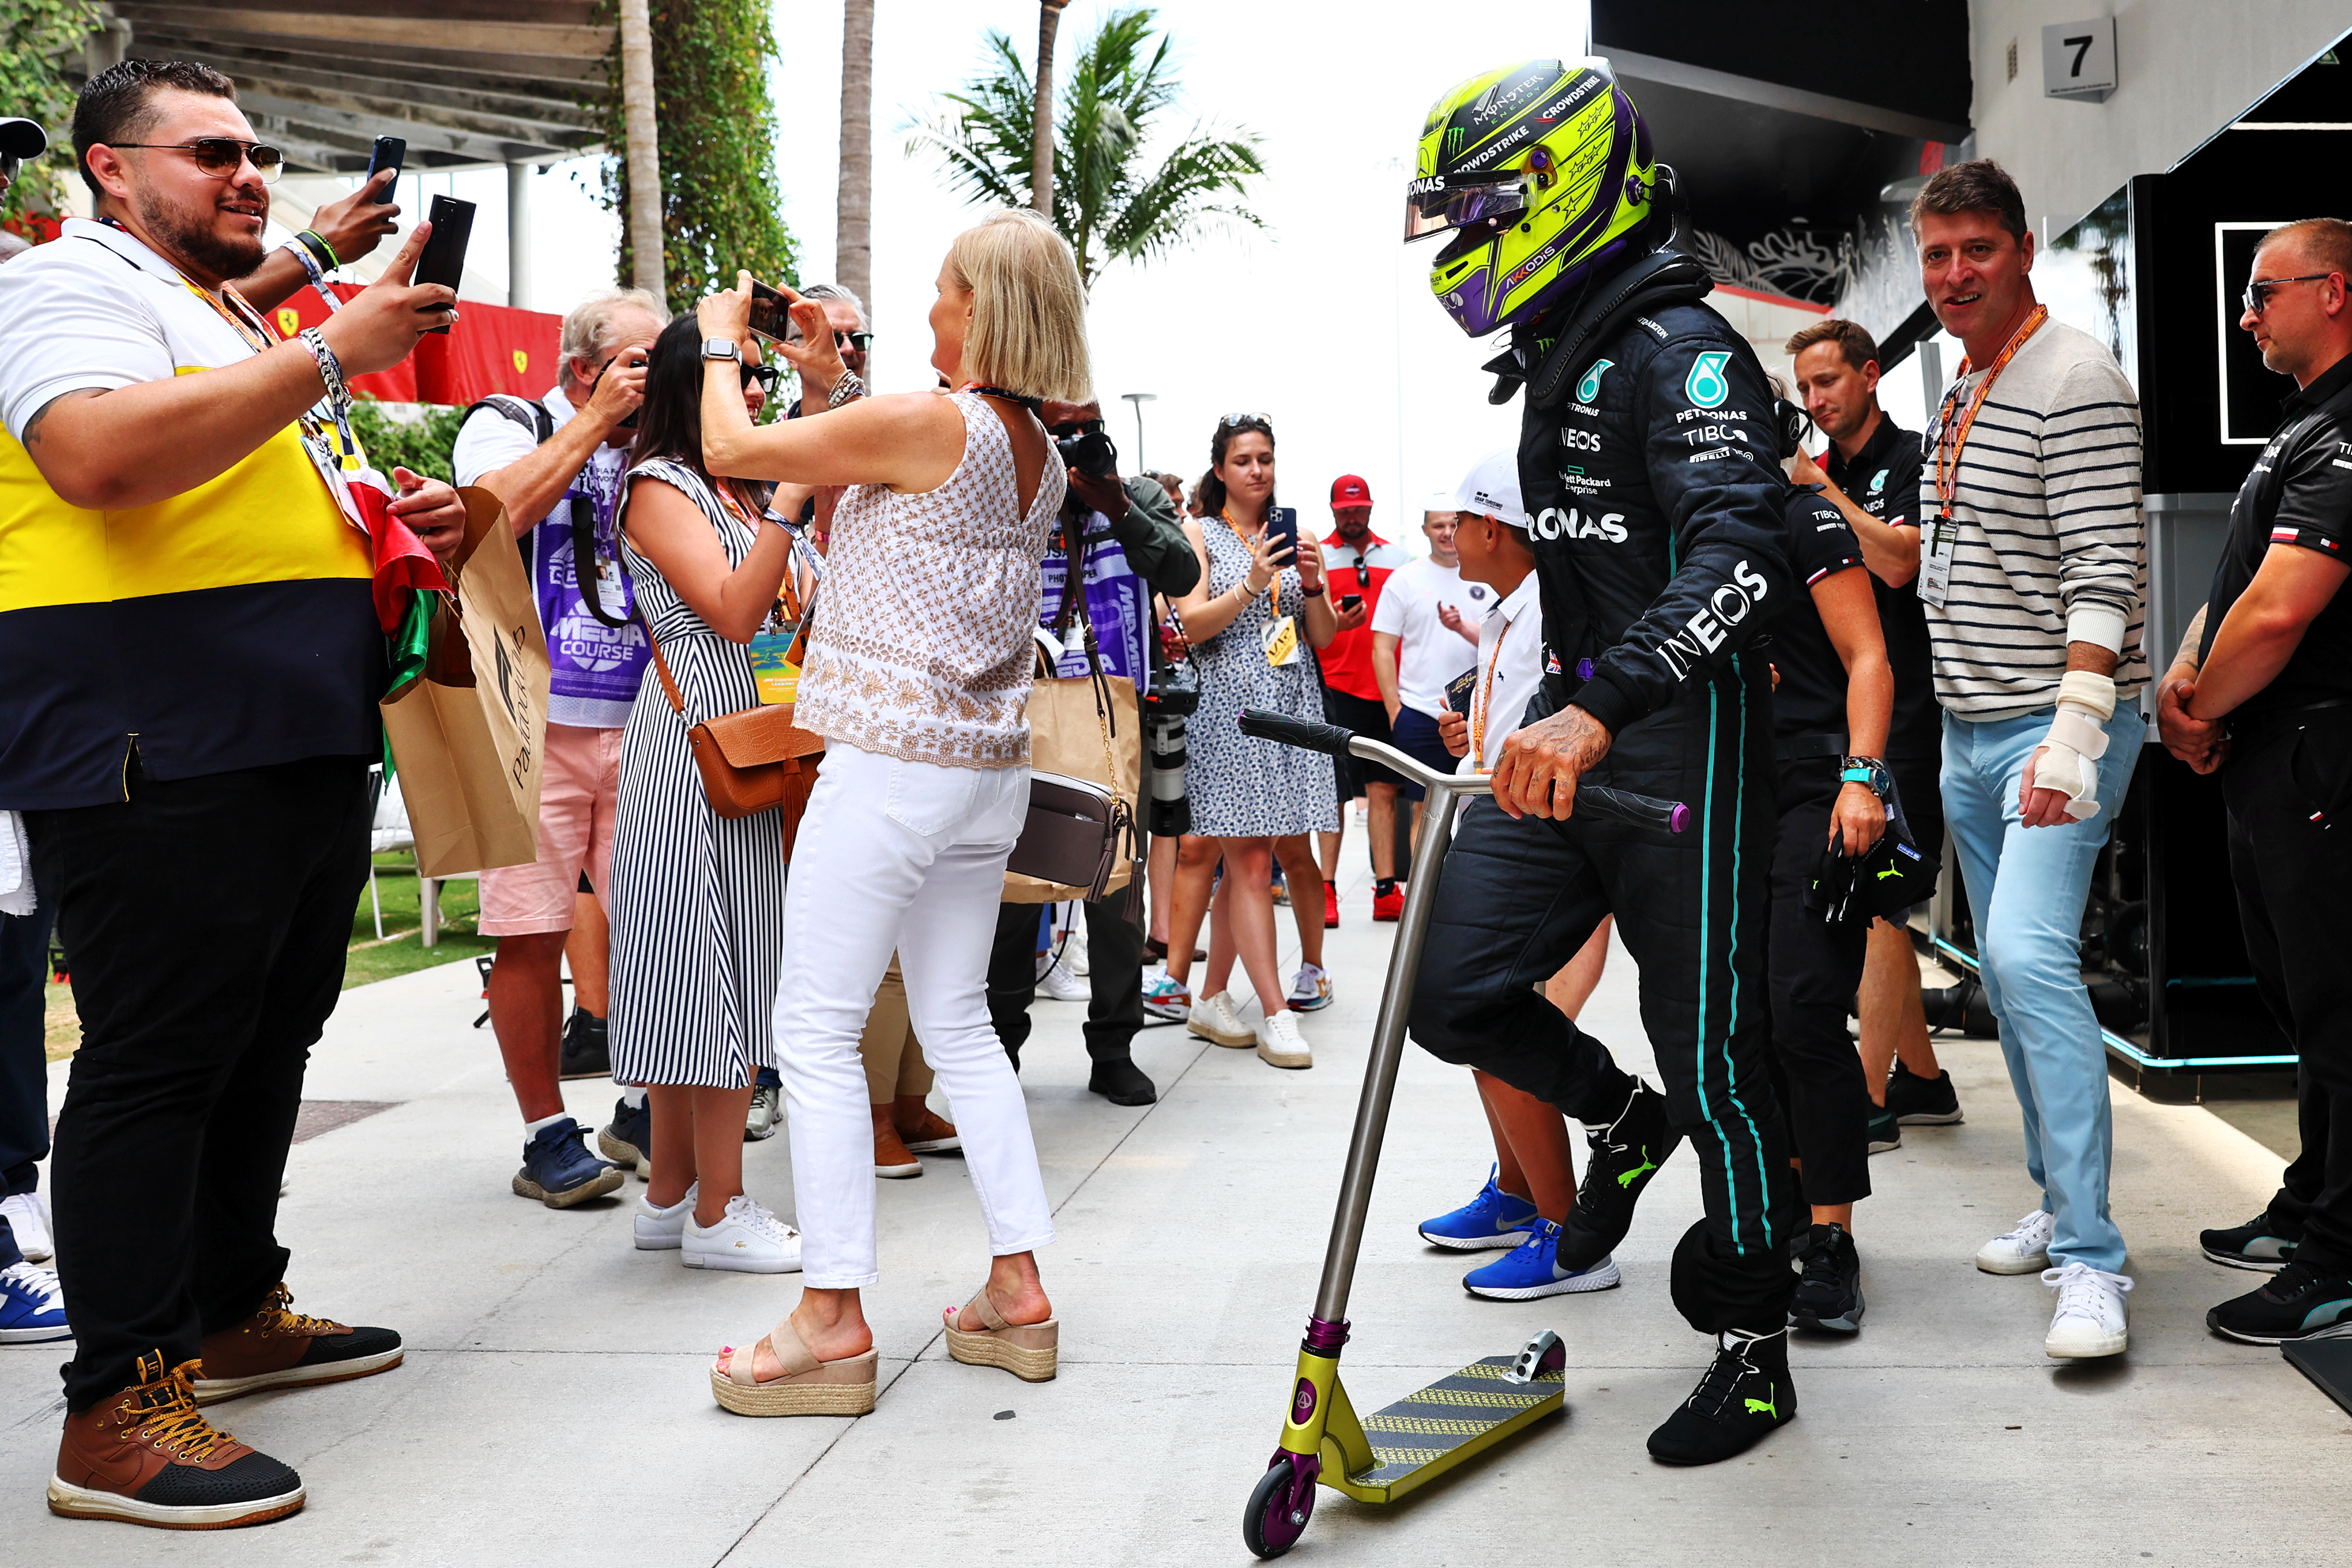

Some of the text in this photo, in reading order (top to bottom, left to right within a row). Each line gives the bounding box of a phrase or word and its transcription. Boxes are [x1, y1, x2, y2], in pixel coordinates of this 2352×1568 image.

[2063, 35, 2093, 77] 7
[1473, 75, 1544, 125] MONSTER
[1490, 87, 1541, 125] ENERGY
[1543, 75, 1602, 120] CROWDSTRIKE
[1567, 402, 1600, 417] PTRONAS
[1559, 427, 1601, 452] NEOS
[1689, 446, 1731, 463] PIRELLI
[1576, 475, 1612, 487] Packard
[1485, 498, 1503, 509] TURISMO
[1656, 560, 1768, 682] INEOS
[560, 641, 634, 661] COURSE
[1451, 675, 1477, 693] HAMILTON
[147, 1361, 159, 1376] LF1
